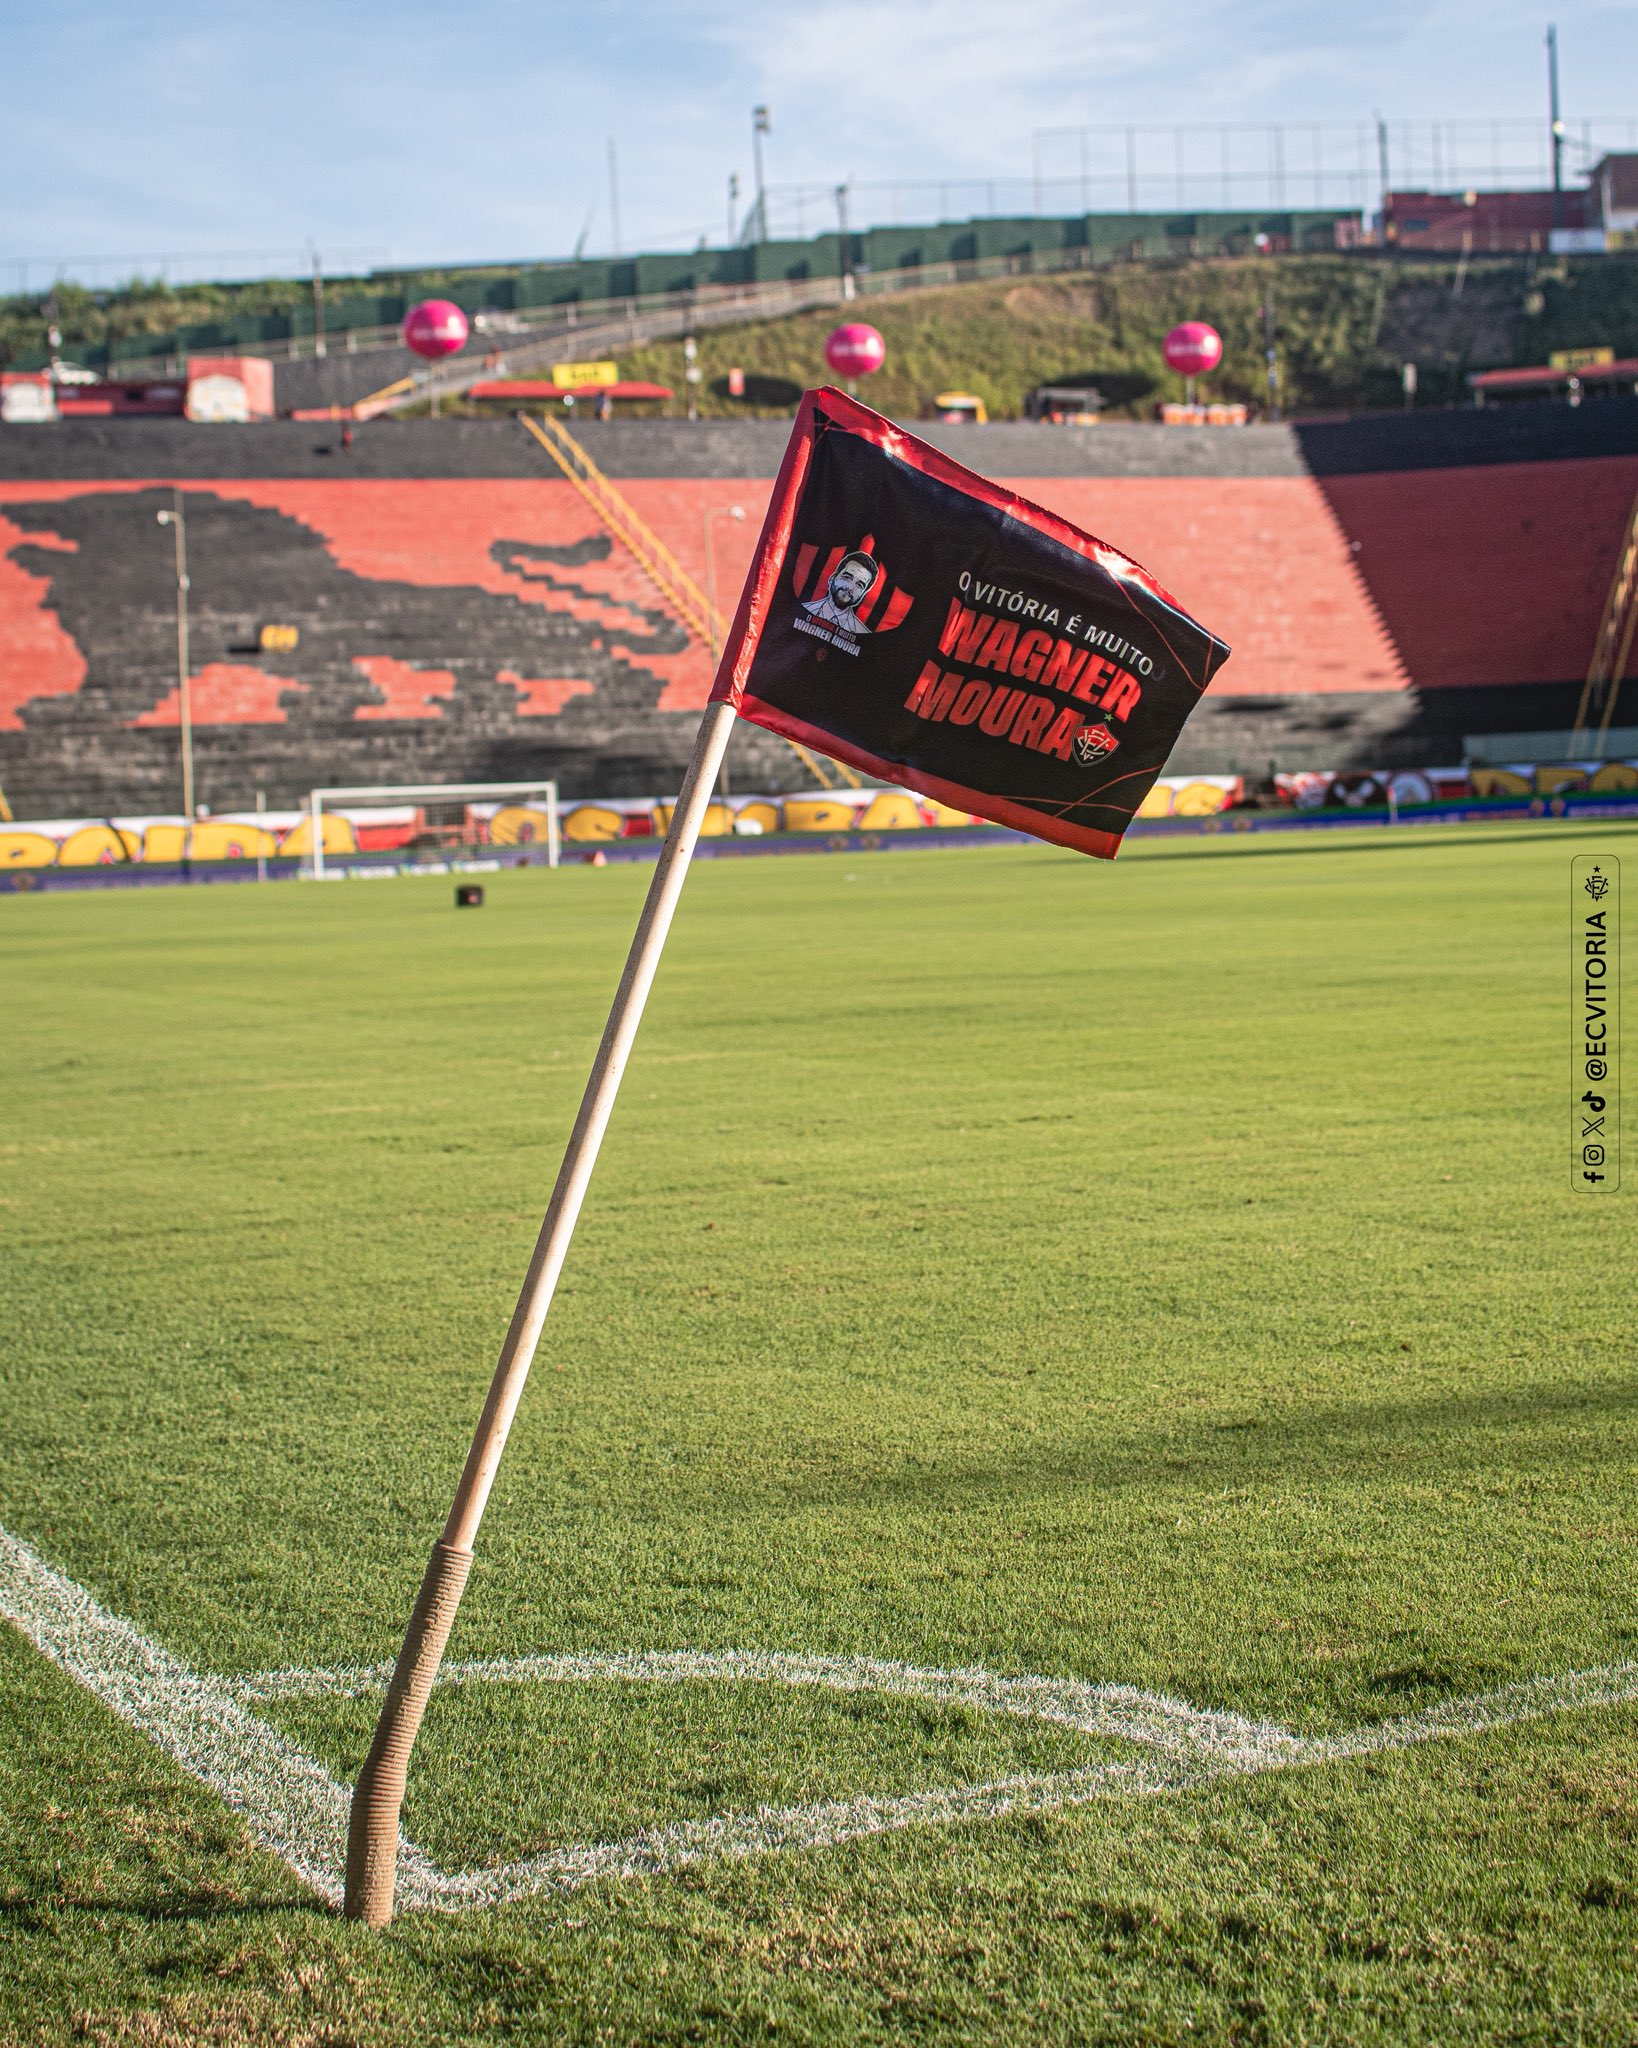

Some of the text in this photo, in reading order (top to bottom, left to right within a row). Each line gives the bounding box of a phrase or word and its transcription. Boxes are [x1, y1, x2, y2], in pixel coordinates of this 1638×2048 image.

[793, 617, 862, 657] WAGNER MOURA
[938, 596, 1143, 724] WAGNER
[958, 571, 1154, 676] O VITÓRIA É MUITO
[903, 659, 1087, 763] MOURA
